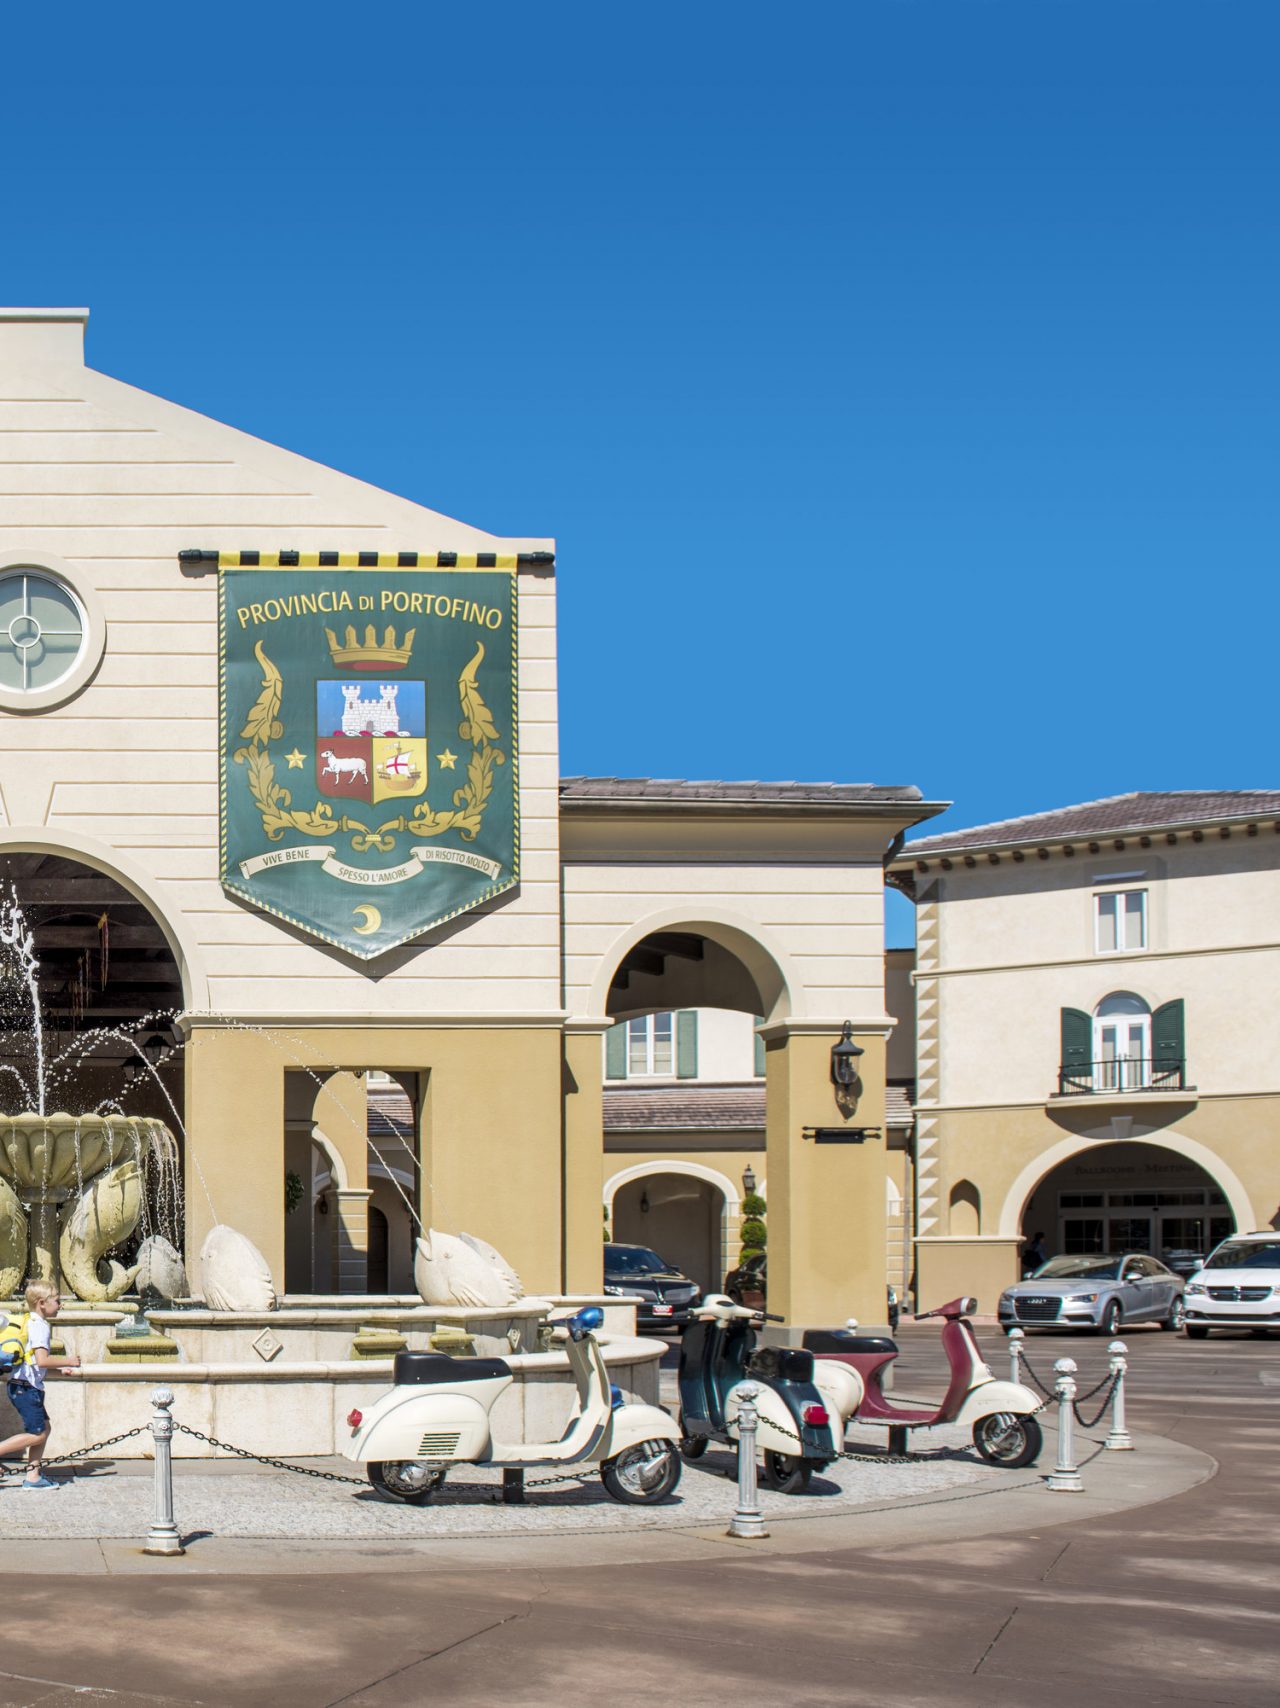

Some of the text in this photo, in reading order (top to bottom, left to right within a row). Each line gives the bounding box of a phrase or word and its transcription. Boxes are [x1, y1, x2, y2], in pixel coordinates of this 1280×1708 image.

[236, 591, 503, 630] PROVINCIA DI PORTOFINO
[262, 850, 310, 866] VIVE BENE
[425, 850, 490, 871] DI RISOTTO MOLTO
[338, 867, 408, 882] SPESSO L'AMORE
